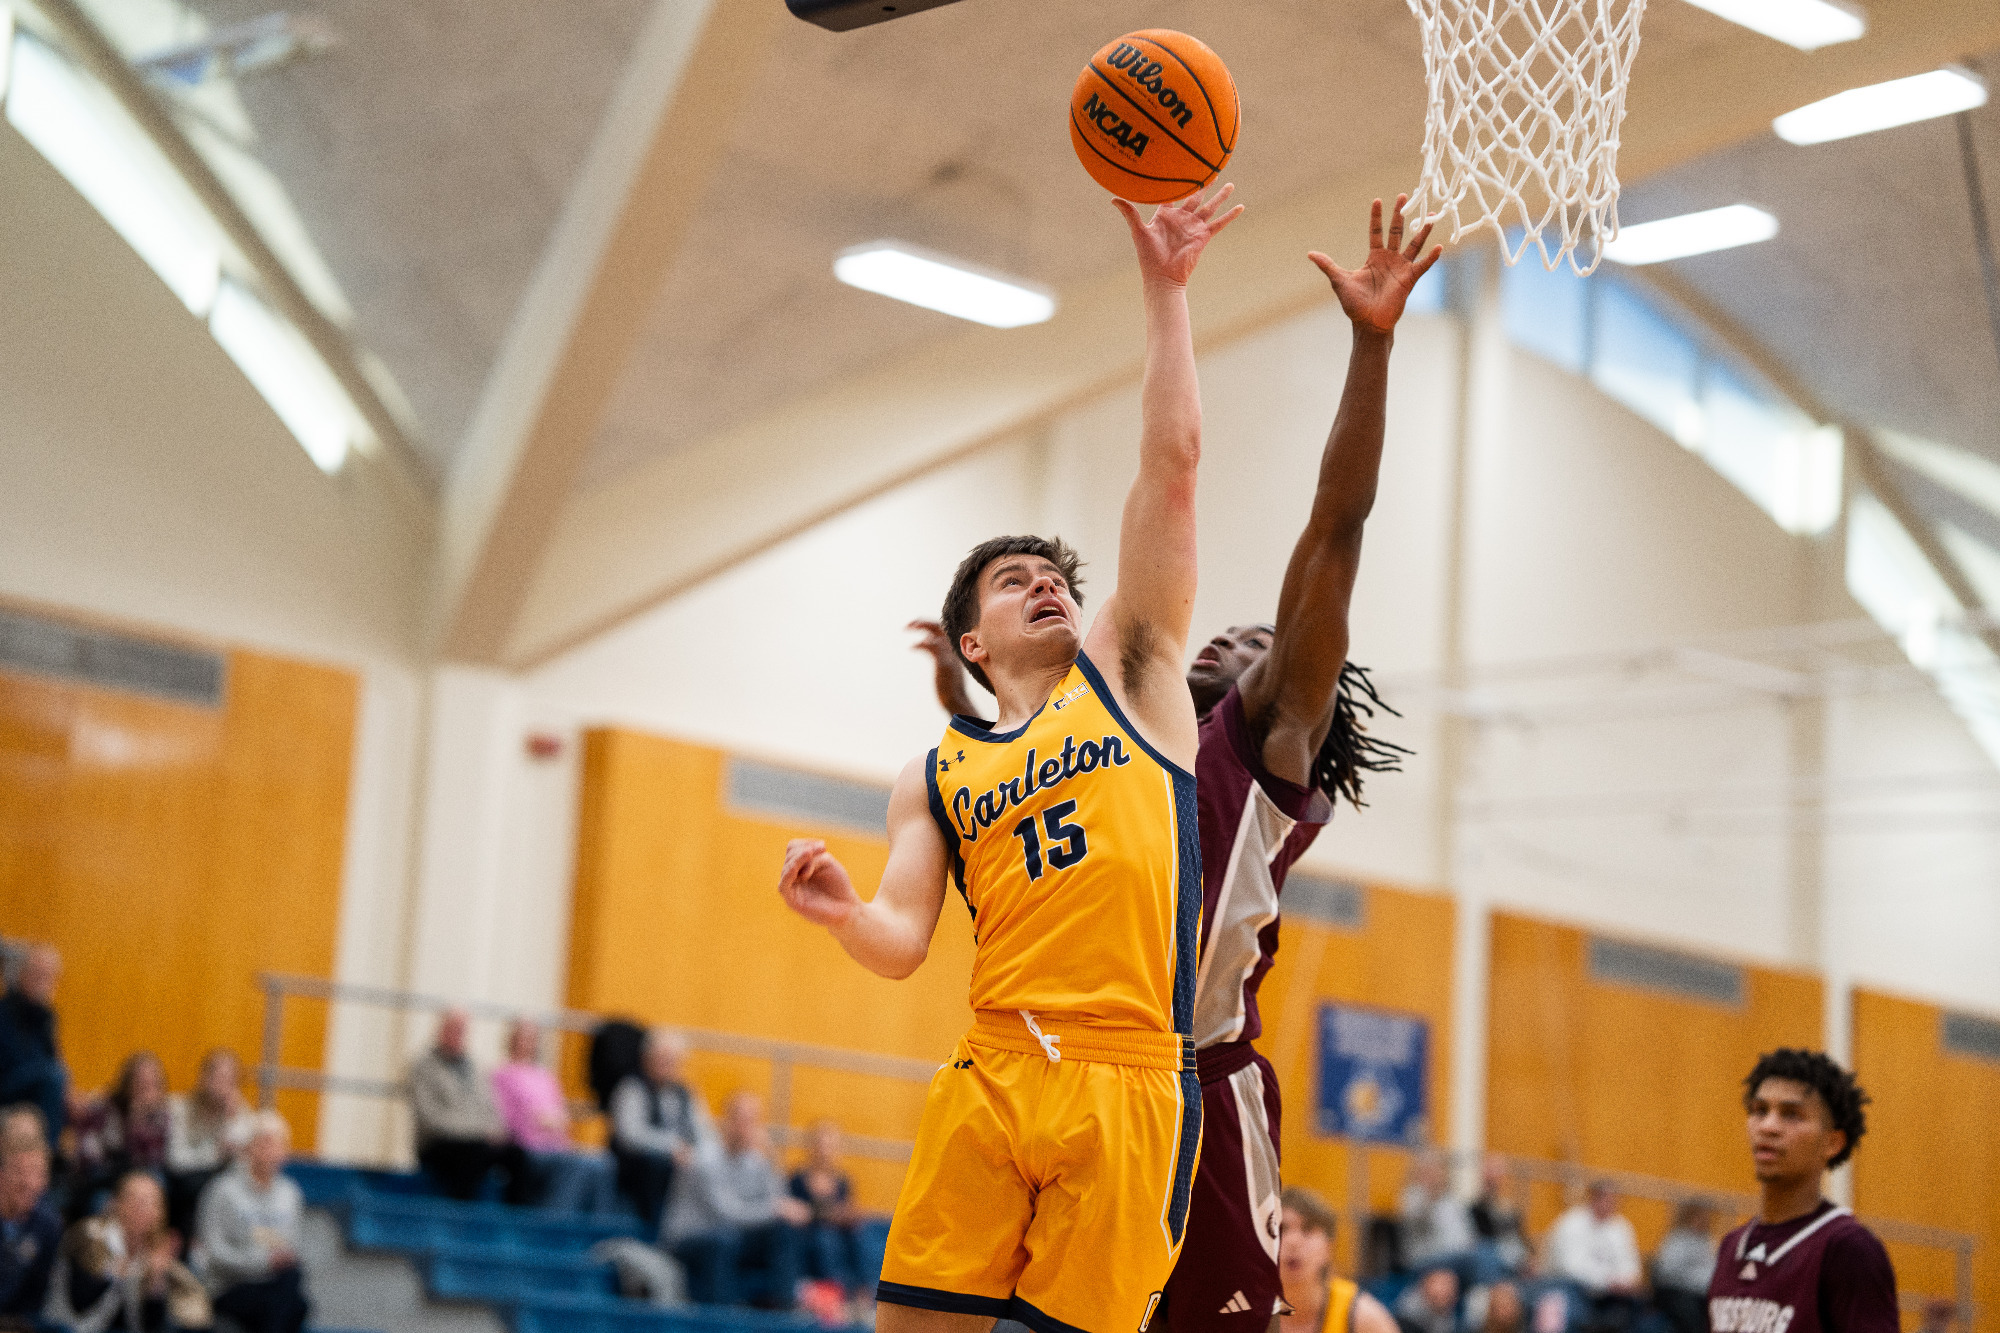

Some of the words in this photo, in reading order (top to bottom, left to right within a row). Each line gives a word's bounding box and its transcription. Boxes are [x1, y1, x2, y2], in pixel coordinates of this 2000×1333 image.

[1083, 92, 1150, 158] NCAA
[1106, 42, 1193, 130] Wilson
[952, 735, 1131, 842] Carleton
[1012, 797, 1088, 884] 15
